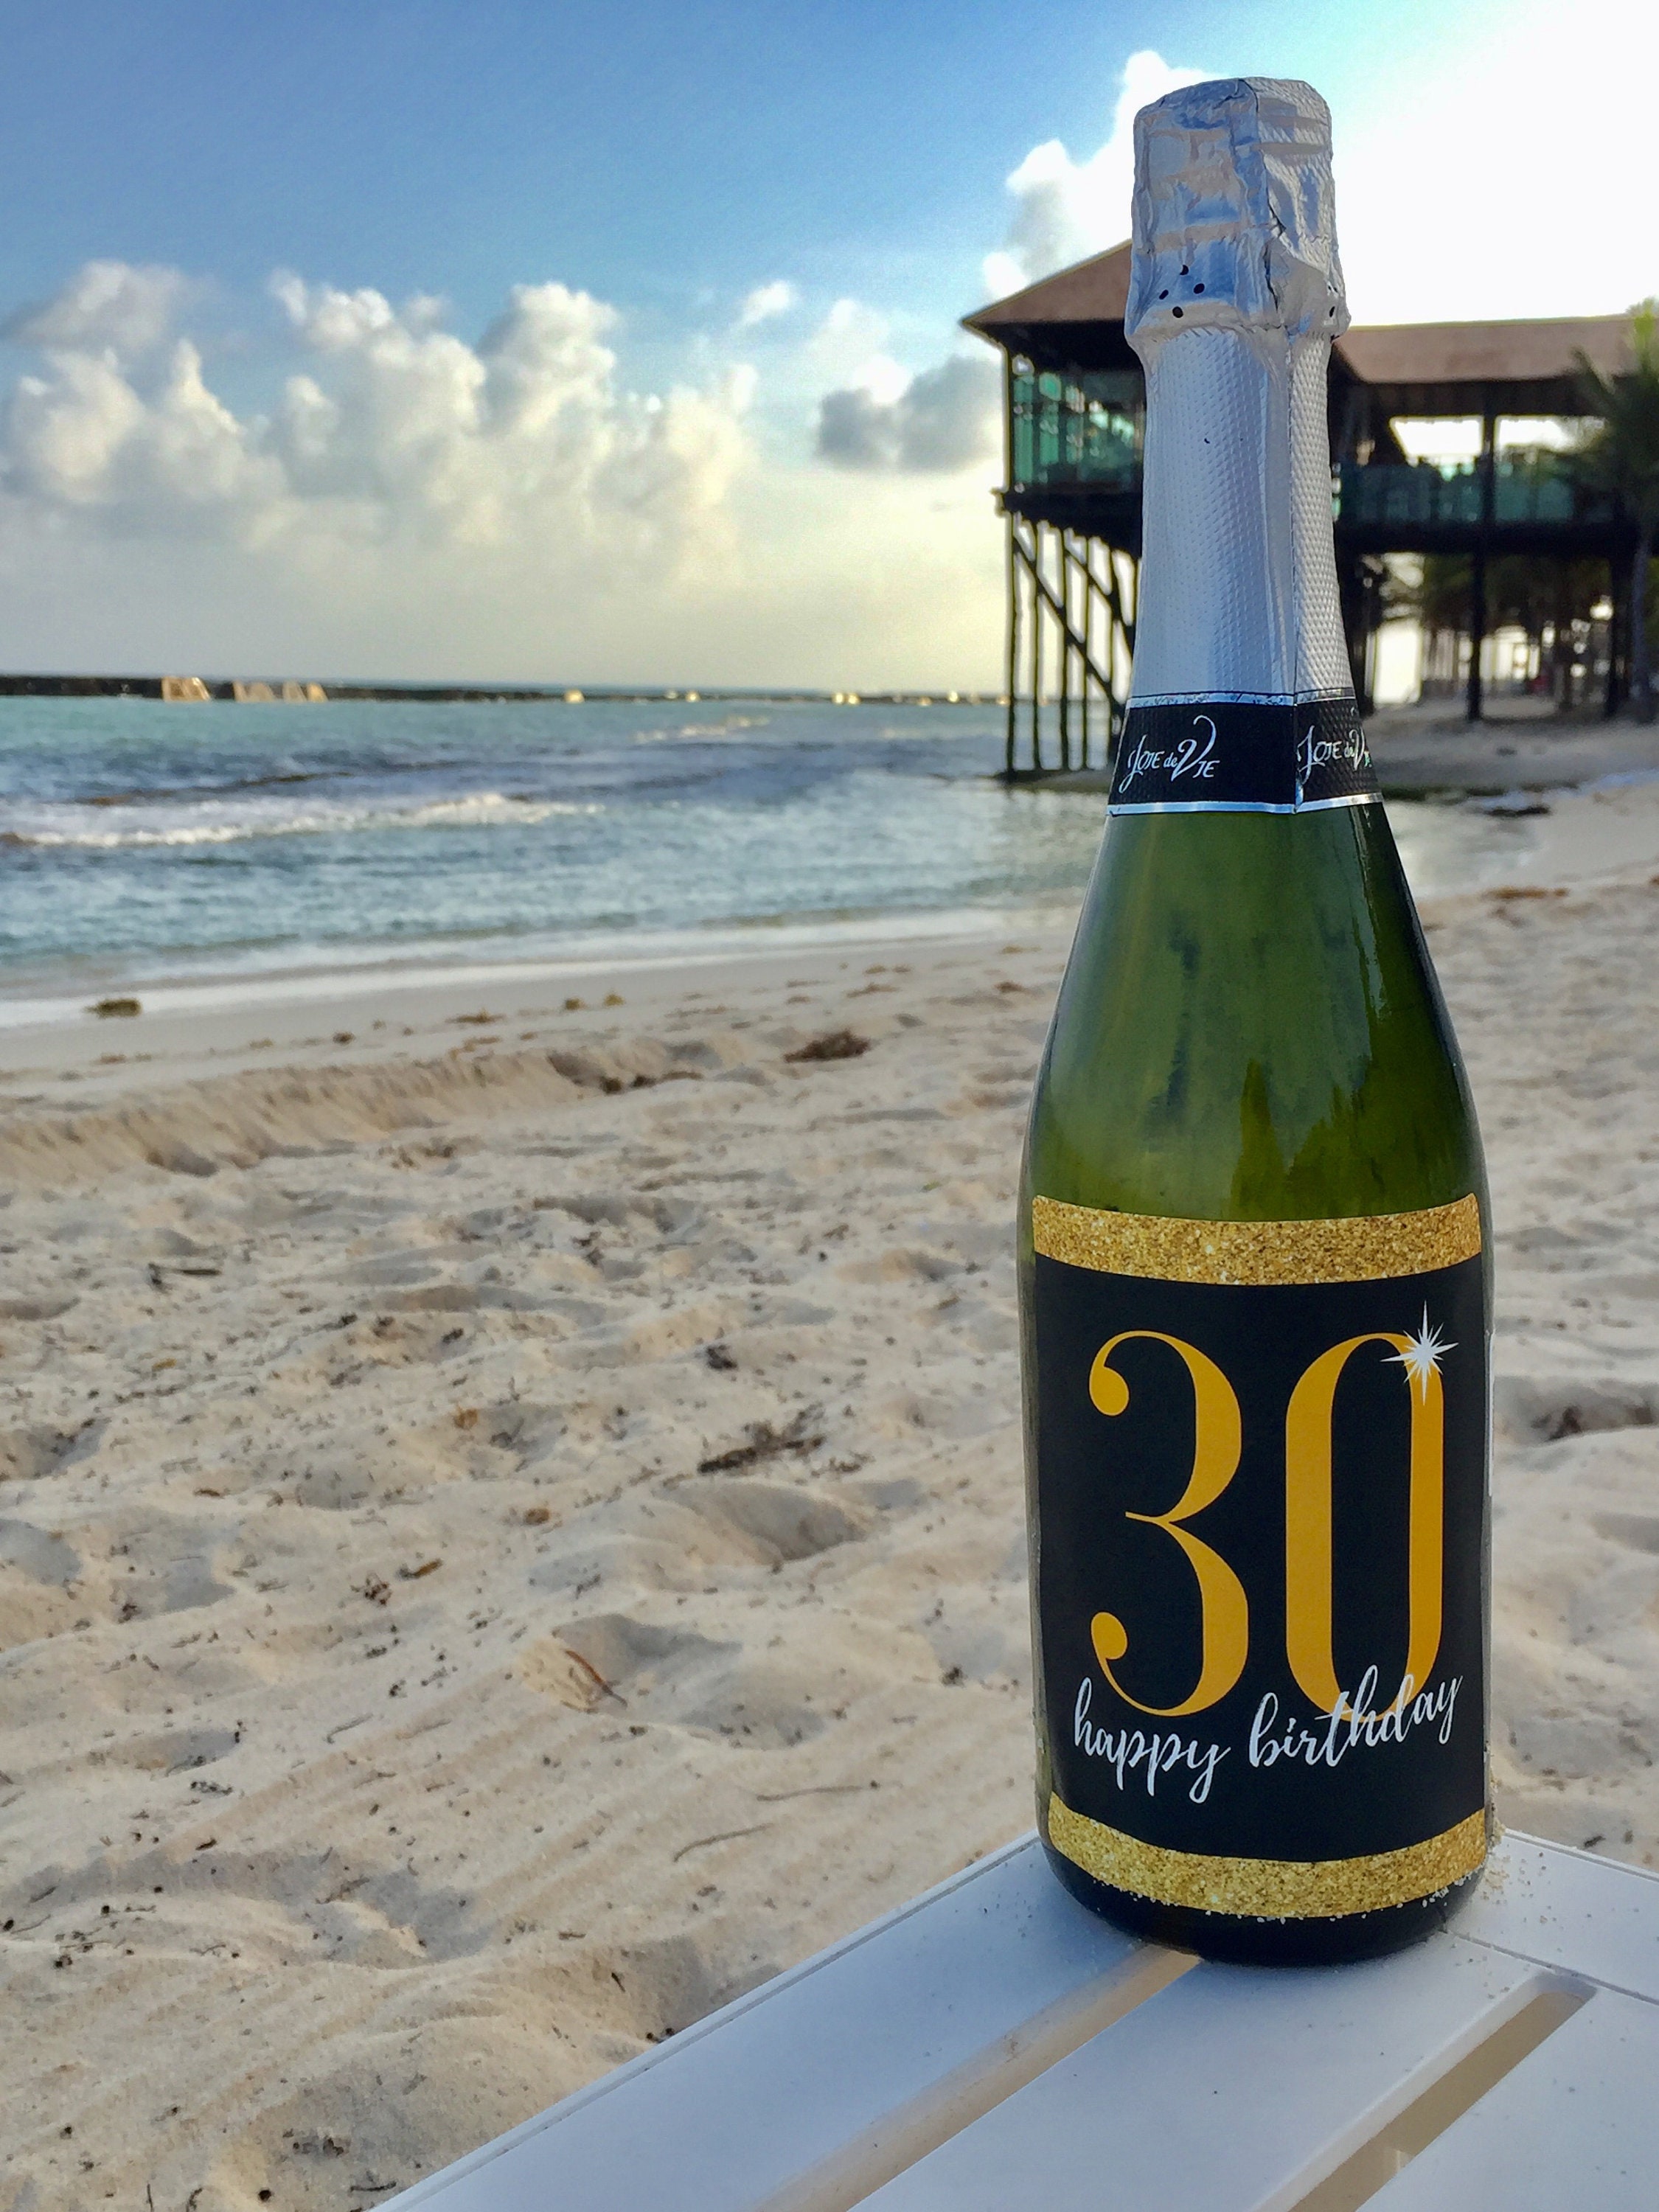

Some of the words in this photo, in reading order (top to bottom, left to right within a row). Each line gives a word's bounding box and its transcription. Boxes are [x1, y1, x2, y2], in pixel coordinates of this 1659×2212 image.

[1164, 752, 1178, 768] de
[1089, 1330, 1443, 1722] 30
[1074, 1677, 1231, 1804] happy
[1248, 1664, 1463, 1767] birthday
